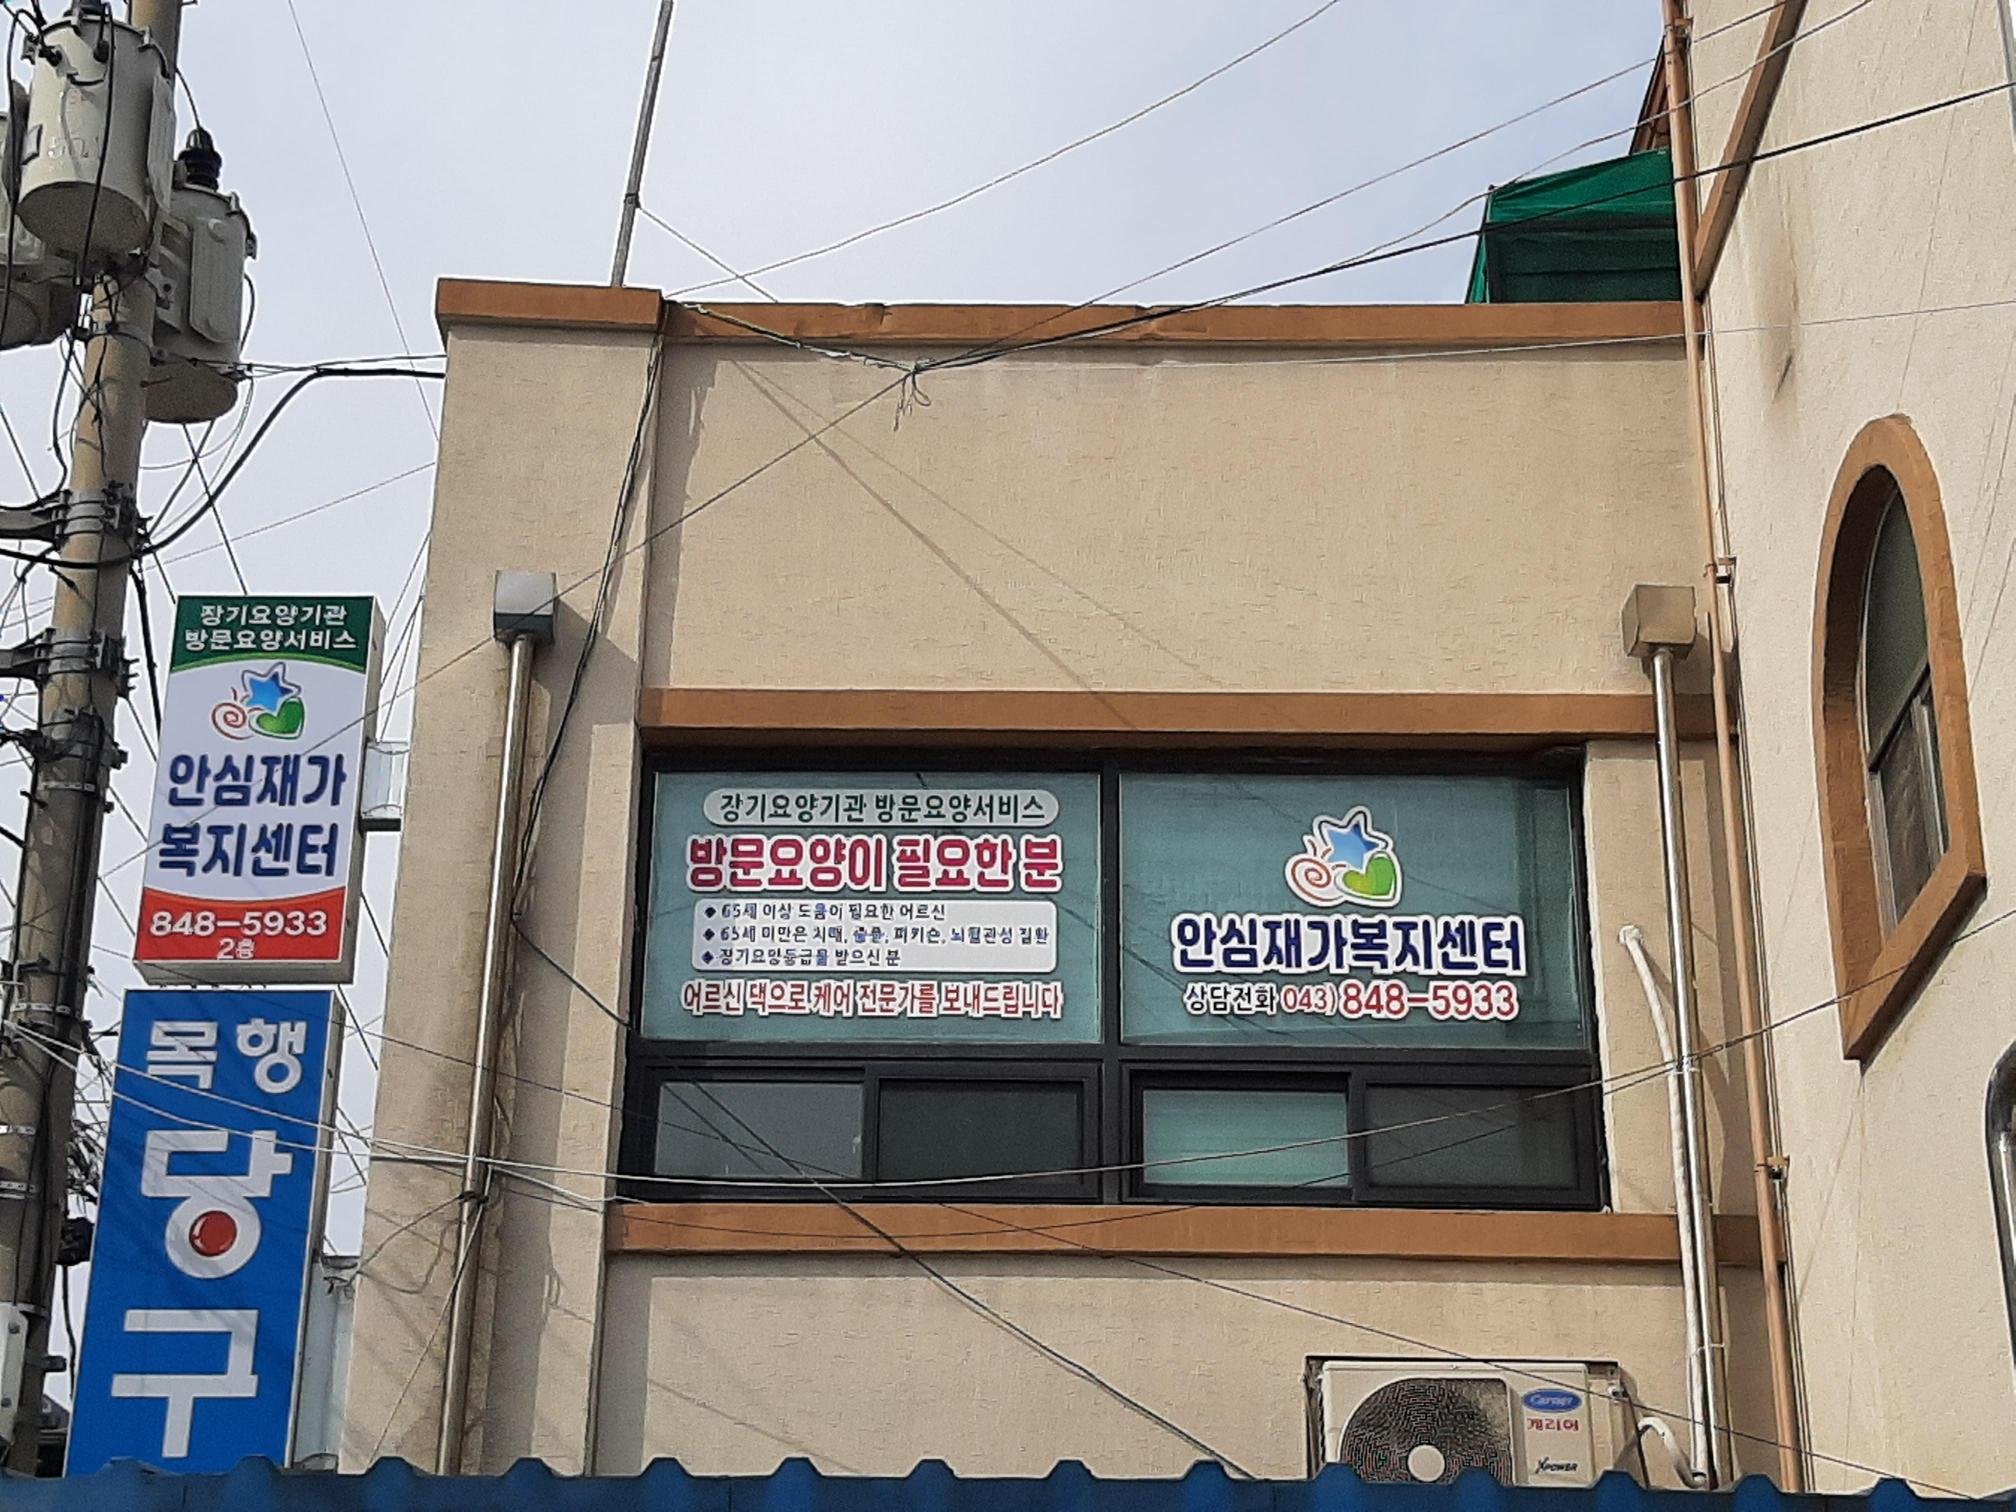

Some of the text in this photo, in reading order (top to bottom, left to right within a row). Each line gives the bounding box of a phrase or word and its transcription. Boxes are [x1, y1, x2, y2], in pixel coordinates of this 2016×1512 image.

[200, 604, 347, 626] 장기요양기관
[184, 629, 357, 651] 방문요양서비스
[168, 753, 347, 807] 안심재가
[719, 793, 1046, 824] 장기요양기관 방문요양서비스
[158, 822, 339, 878] 복지센터
[690, 837, 1059, 888] 방문요양이 필요한 분
[150, 910, 328, 937] 848-5933
[721, 903, 757, 919] 65세
[763, 903, 792, 920] 이상
[798, 903, 843, 920] 도움이
[900, 904, 945, 921] 어르신
[720, 925, 756, 943] 65세
[761, 925, 807, 943] 미만은
[1175, 916, 1523, 972] 안심재가복지센터
[834, 949, 880, 967] 받으신
[885, 949, 901, 967] 분
[683, 981, 1061, 1016] 어르신 댁으로 케어 전문가를 보내드립니다
[1186, 982, 1516, 1017] 상담전화 043) 848-5933
[146, 1018, 307, 1094] 목행
